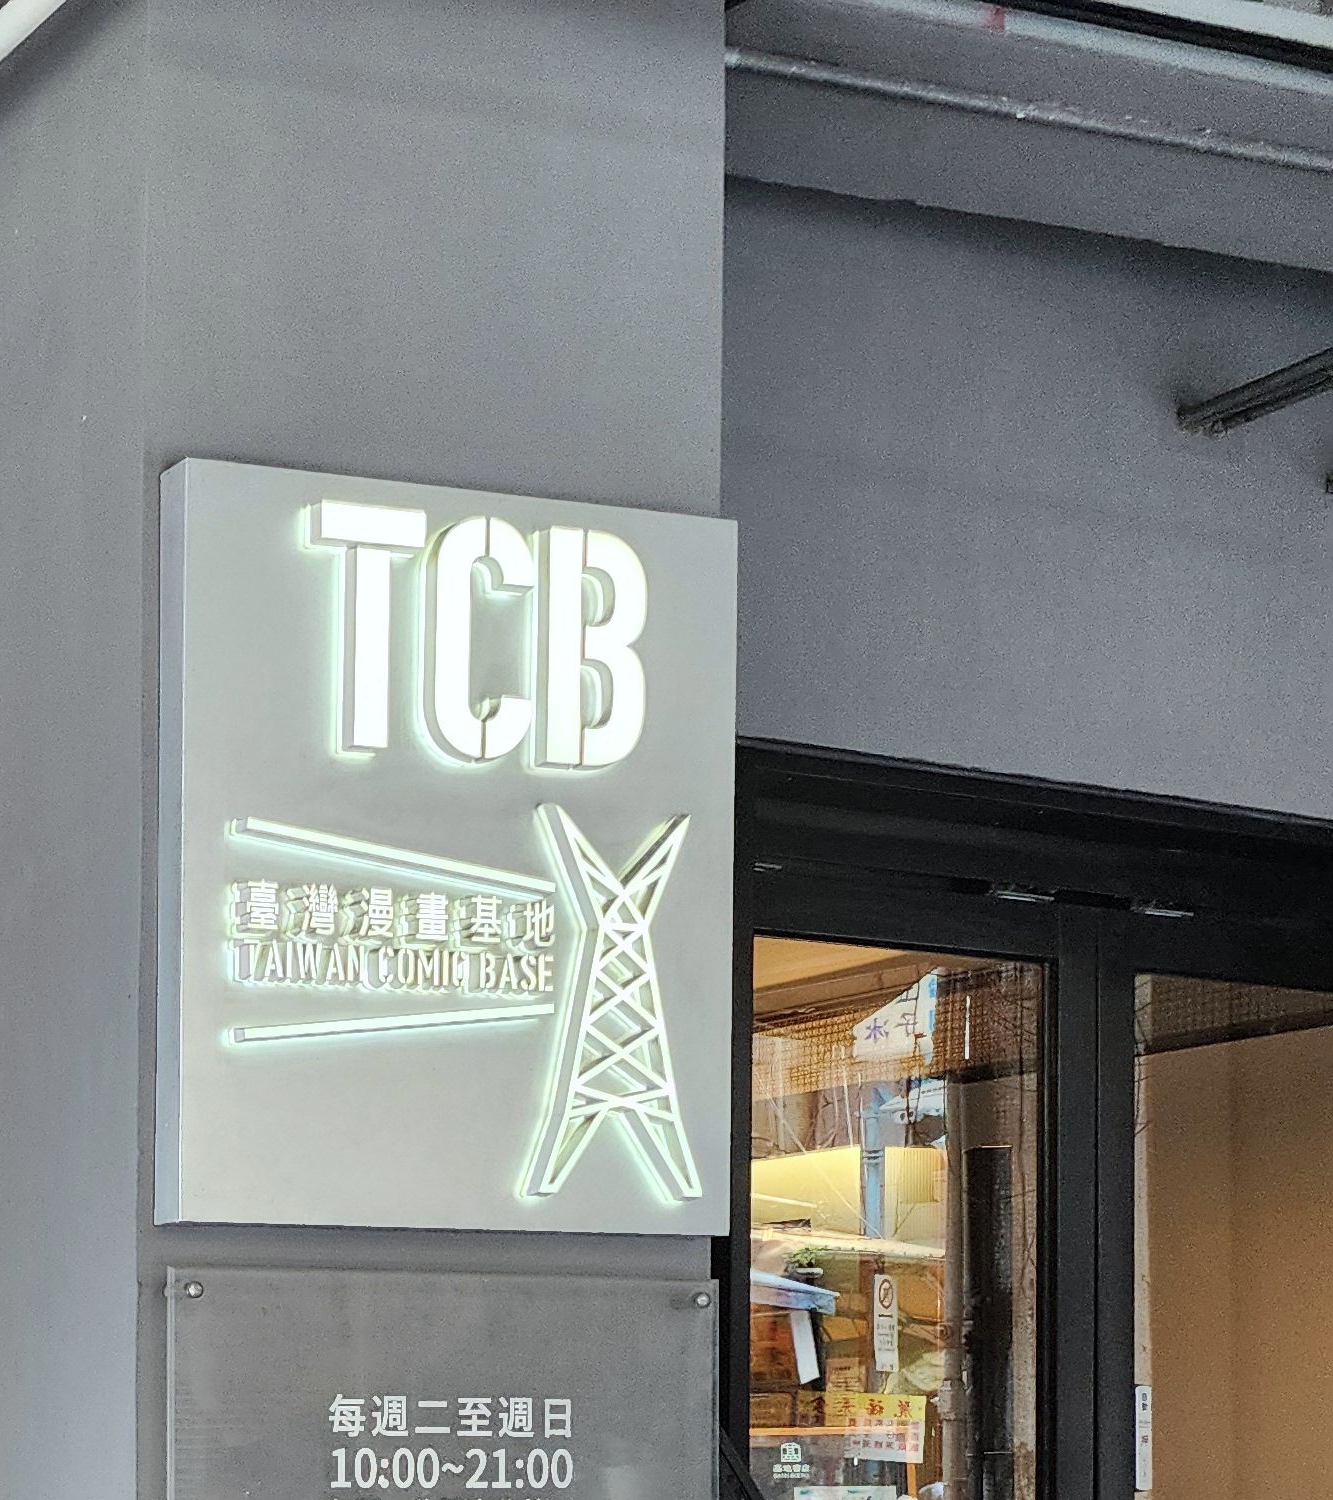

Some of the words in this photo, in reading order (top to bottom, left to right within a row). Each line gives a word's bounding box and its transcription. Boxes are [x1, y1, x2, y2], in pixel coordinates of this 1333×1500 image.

[302, 500, 647, 771] TCB
[243, 878, 557, 948] 臺灣漫畫基地
[242, 940, 365, 982] TAIWAN
[378, 945, 471, 986] COMIC
[484, 953, 555, 992] BASE
[328, 1393, 573, 1439] 每週二至週日
[330, 1447, 574, 1489] 10:00~21:00
